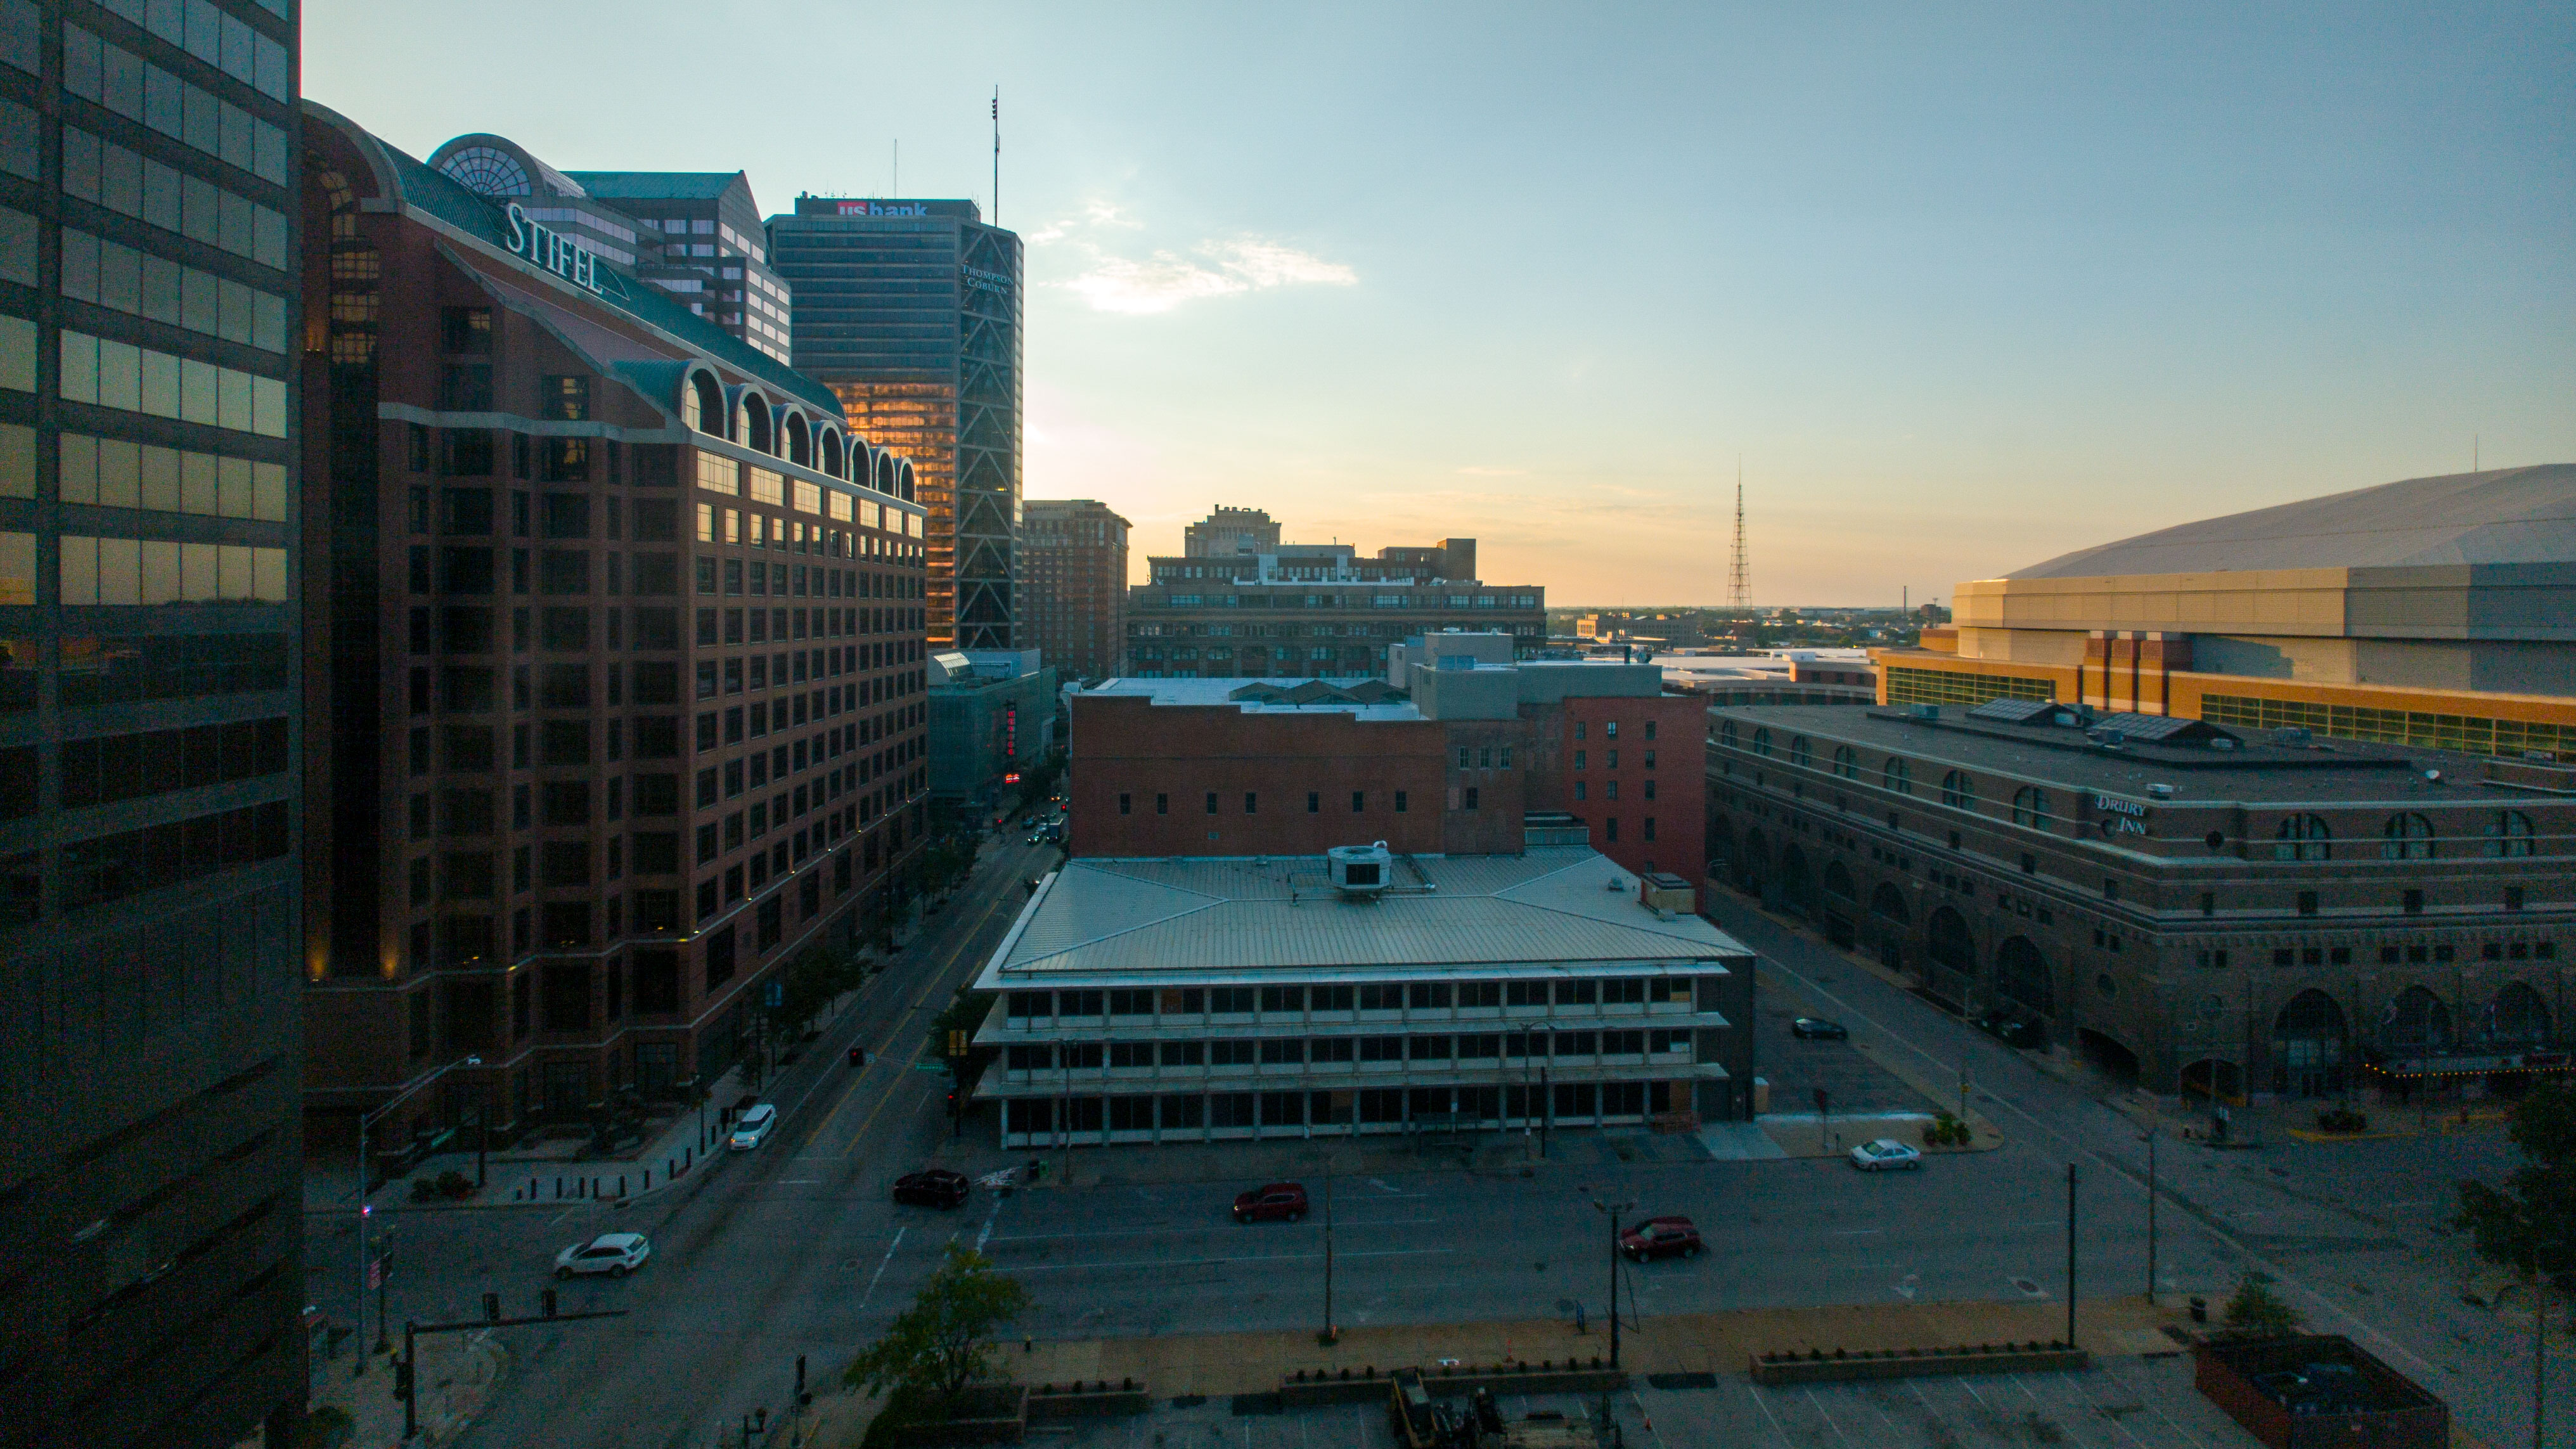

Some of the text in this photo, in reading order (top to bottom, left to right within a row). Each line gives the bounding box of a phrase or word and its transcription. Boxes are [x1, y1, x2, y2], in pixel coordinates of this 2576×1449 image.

[508, 202, 603, 295] STIFEL
[961, 264, 1014, 285] THOMPSON
[967, 277, 1007, 293] COBURN
[2094, 794, 2146, 817] DRURY
[2116, 816, 2146, 835] INN
